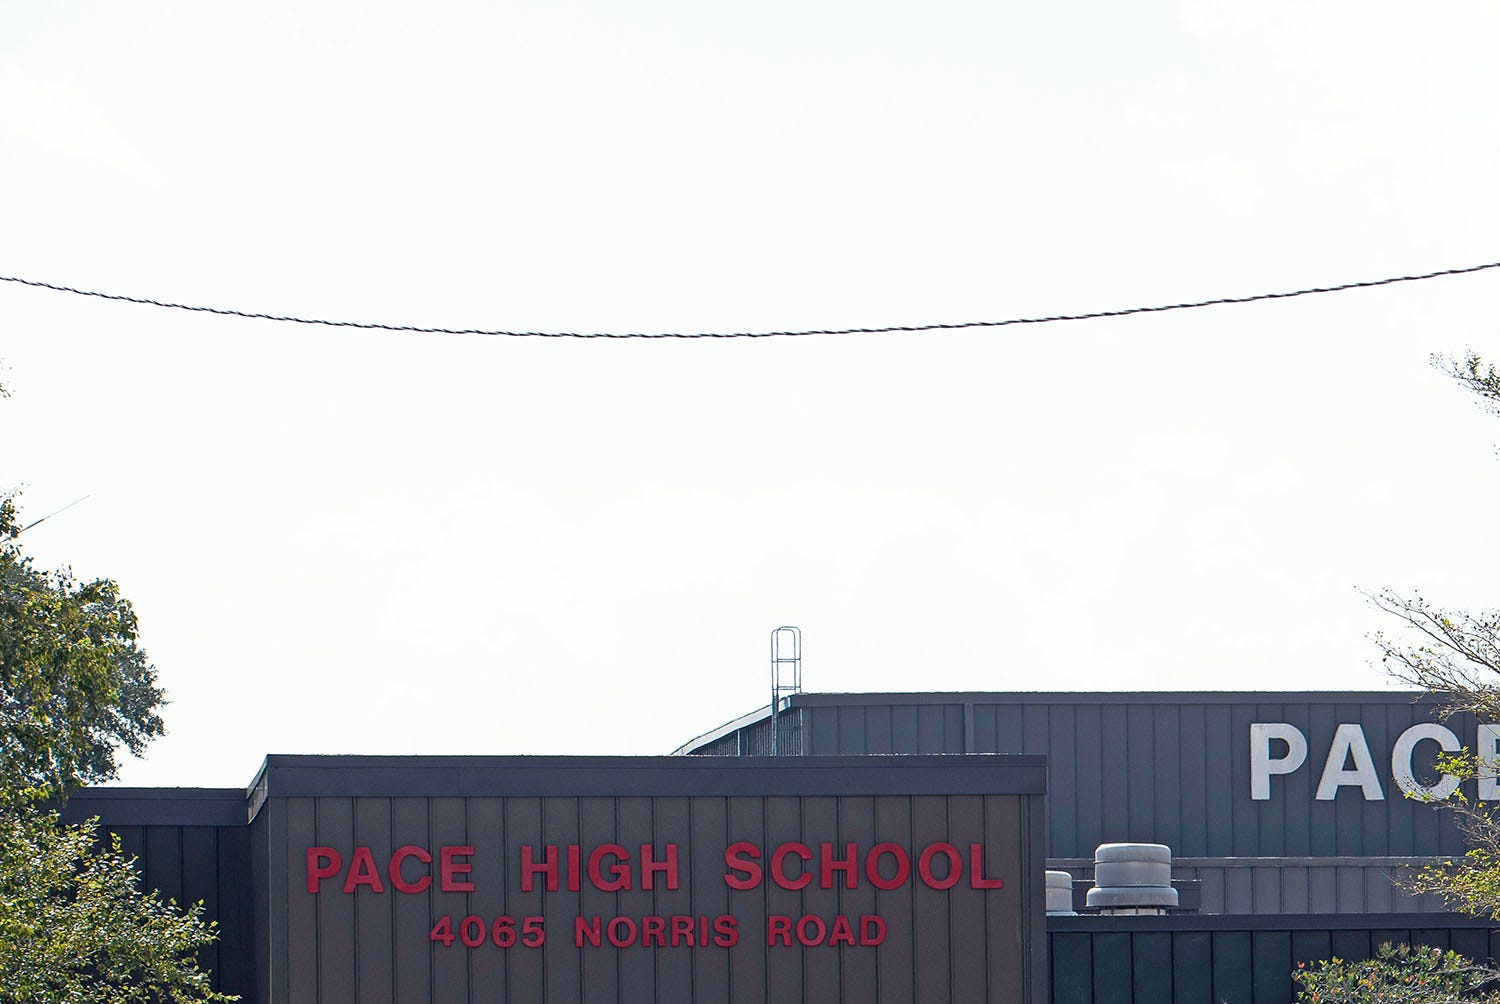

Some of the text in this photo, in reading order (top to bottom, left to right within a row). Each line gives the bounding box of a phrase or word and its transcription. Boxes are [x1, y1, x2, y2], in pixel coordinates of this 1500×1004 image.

[306, 841, 1003, 893] PACE HIGH SCHOOL
[429, 914, 887, 948] 4065 NORRIS ROAD
